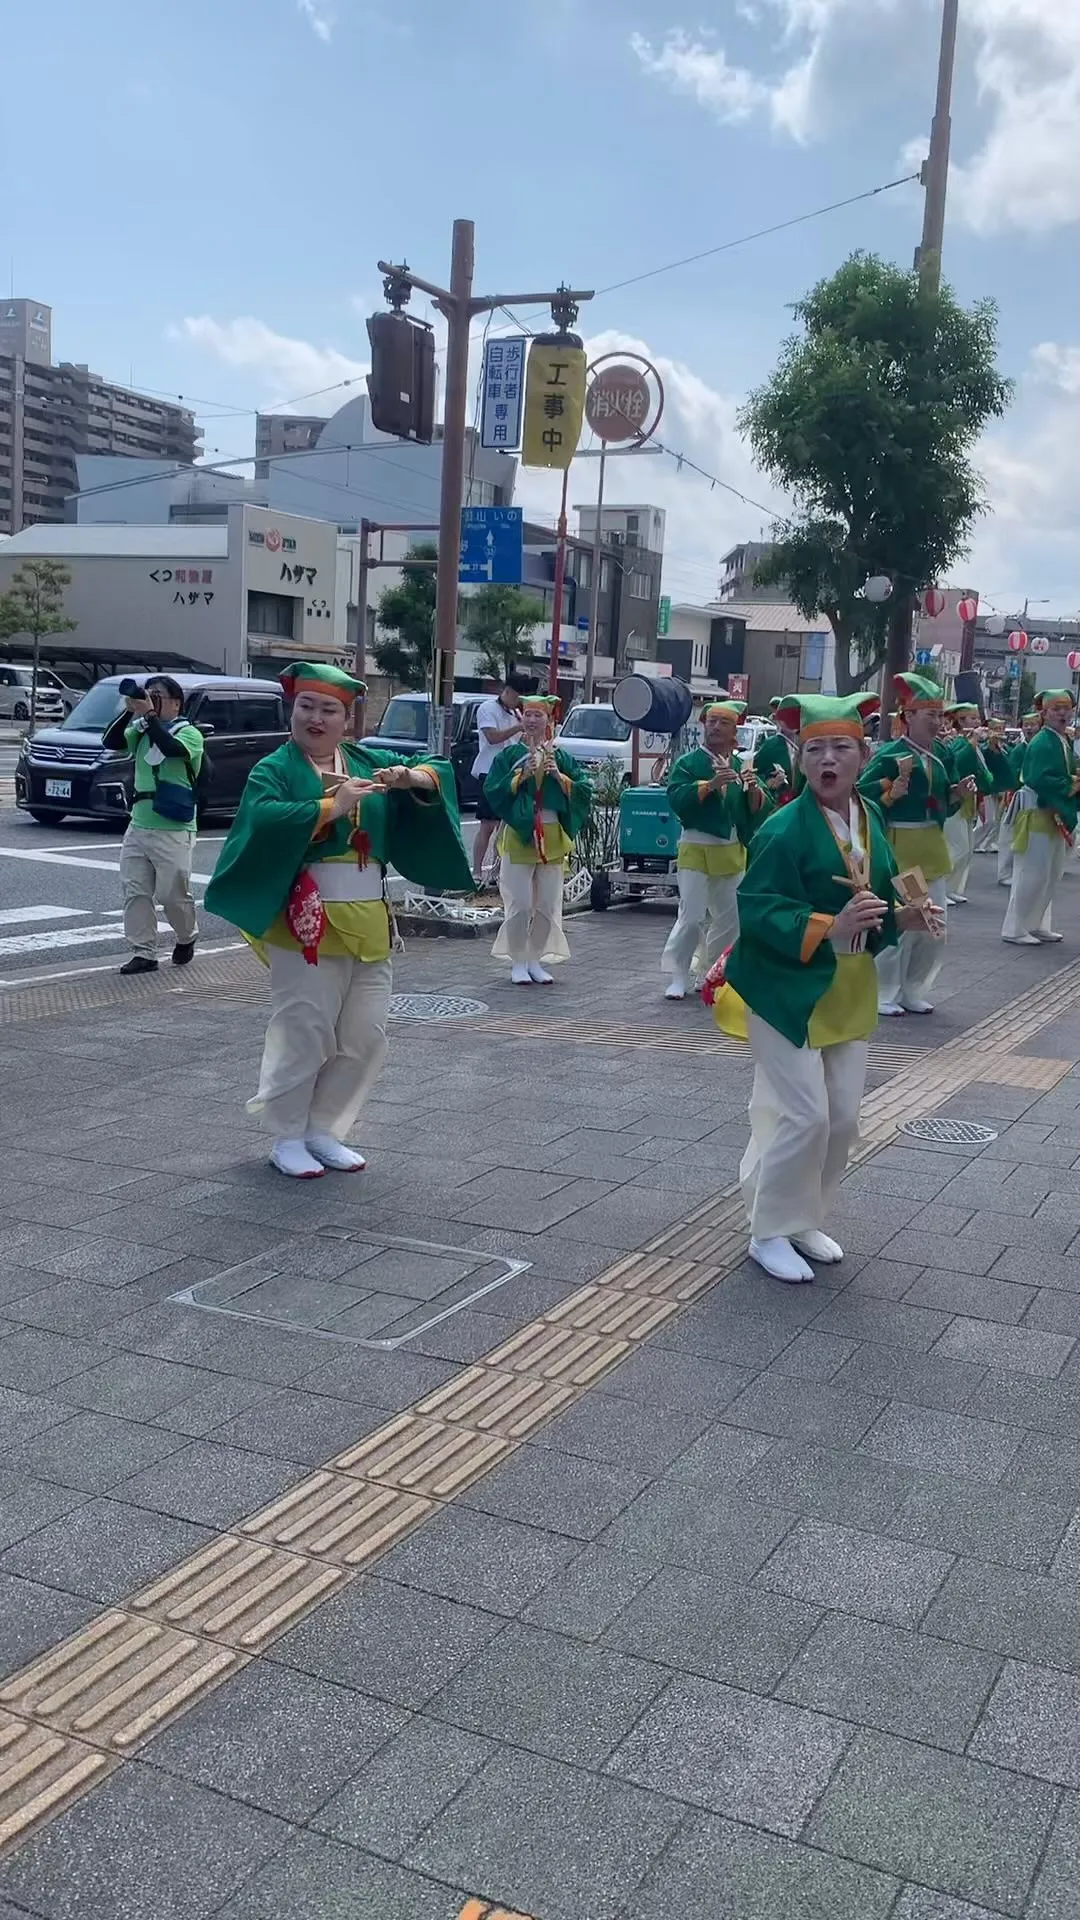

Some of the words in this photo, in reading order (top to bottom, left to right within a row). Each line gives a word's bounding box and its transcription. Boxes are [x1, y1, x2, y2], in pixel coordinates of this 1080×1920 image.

[488, 346, 503, 400] 自転車
[504, 346, 520, 399] 歩行者
[542, 363, 569, 453] 工事中
[591, 389, 644, 418] 消火栓
[494, 404, 508, 441] 専用
[280, 562, 317, 585] ハザマ
[173, 591, 214, 605] ハザマ
